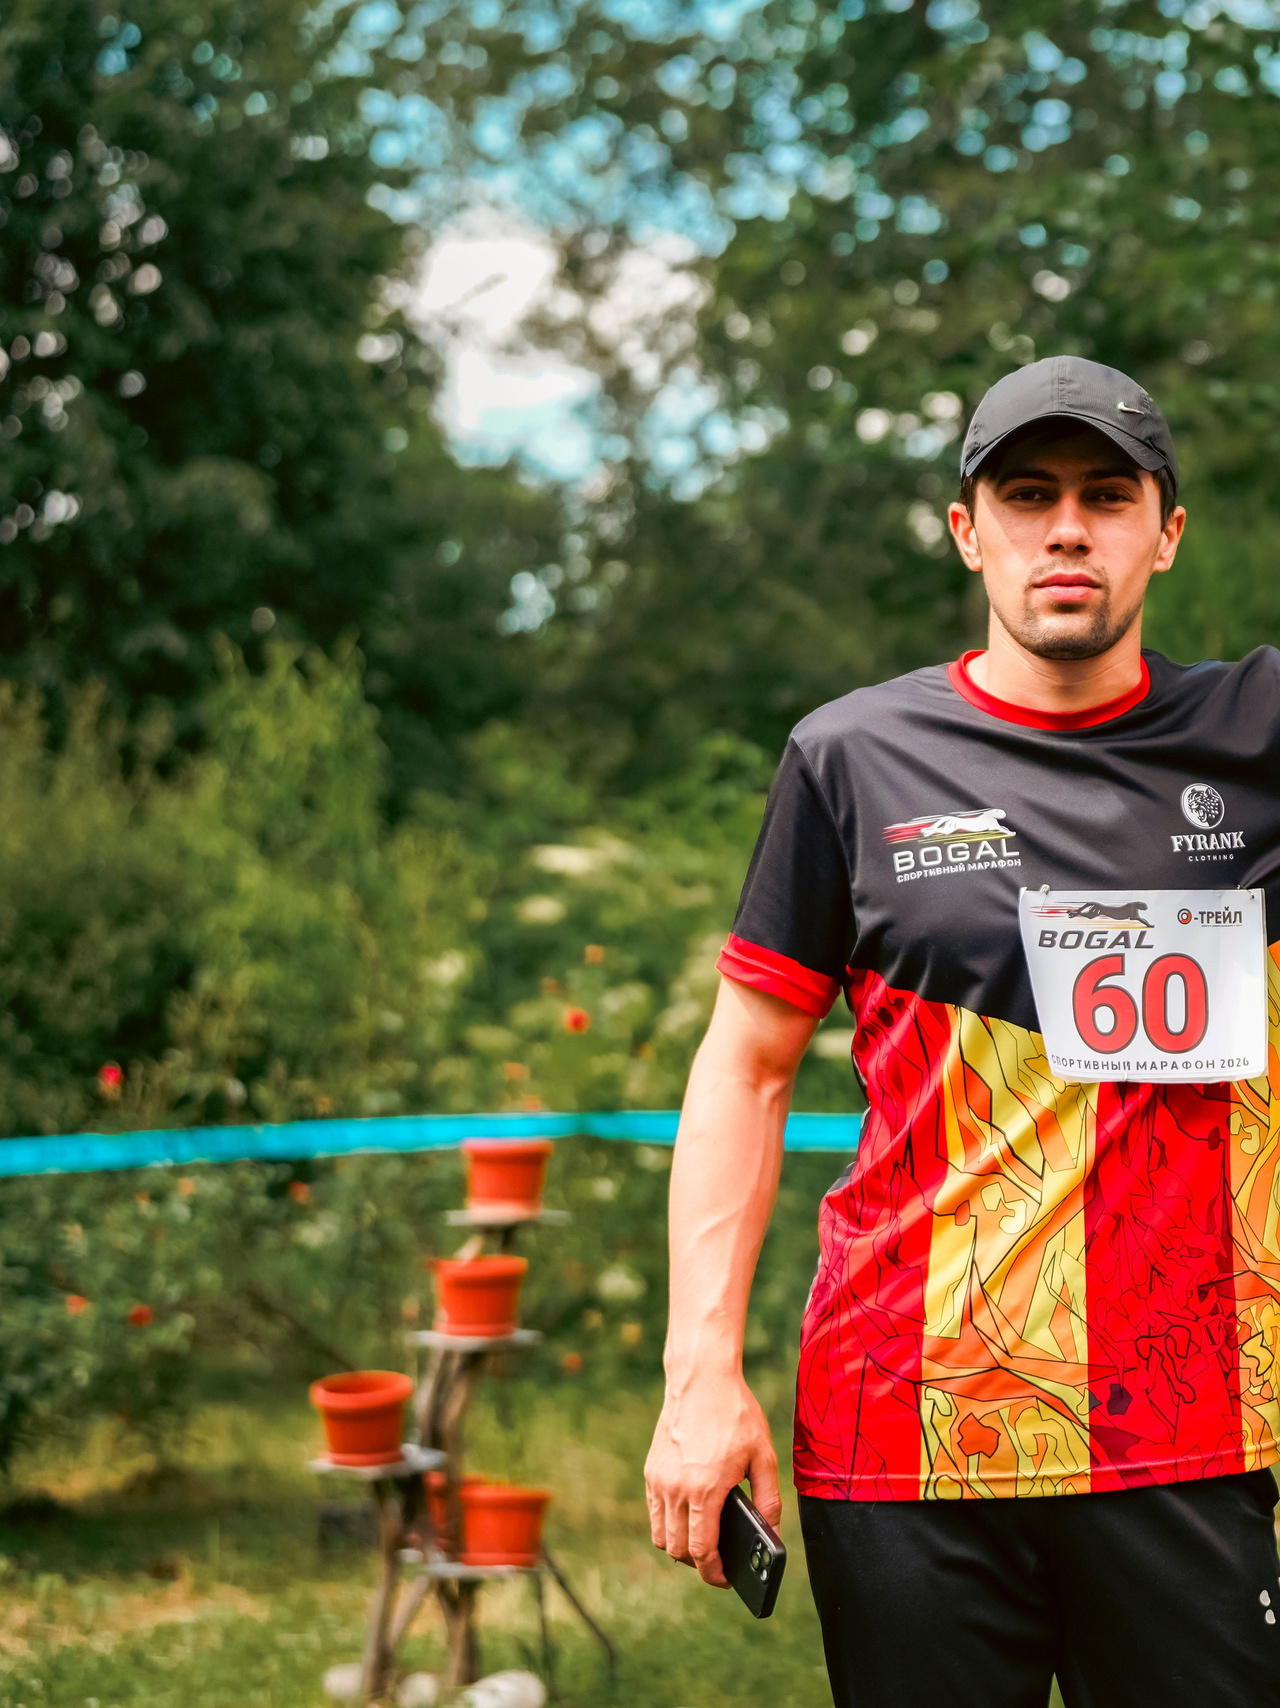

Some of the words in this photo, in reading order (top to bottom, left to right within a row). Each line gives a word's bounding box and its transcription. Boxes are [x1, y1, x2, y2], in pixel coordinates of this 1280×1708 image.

[1170, 831, 1246, 853] FYRANK
[893, 838, 1020, 873] BOGAL
[1188, 853, 1235, 862] CLOTHING
[896, 862, 966, 883] СПОРТИВНЫЙ
[967, 858, 1022, 872] МАРАФОН
[1038, 930, 1155, 949] BOGAL
[1072, 953, 1209, 1055] 60
[1051, 1054, 1131, 1071] СПОРТИВНЫЙ
[1136, 1060, 1215, 1071] МАРАФОН
[1220, 1057, 1250, 1069] 2026
